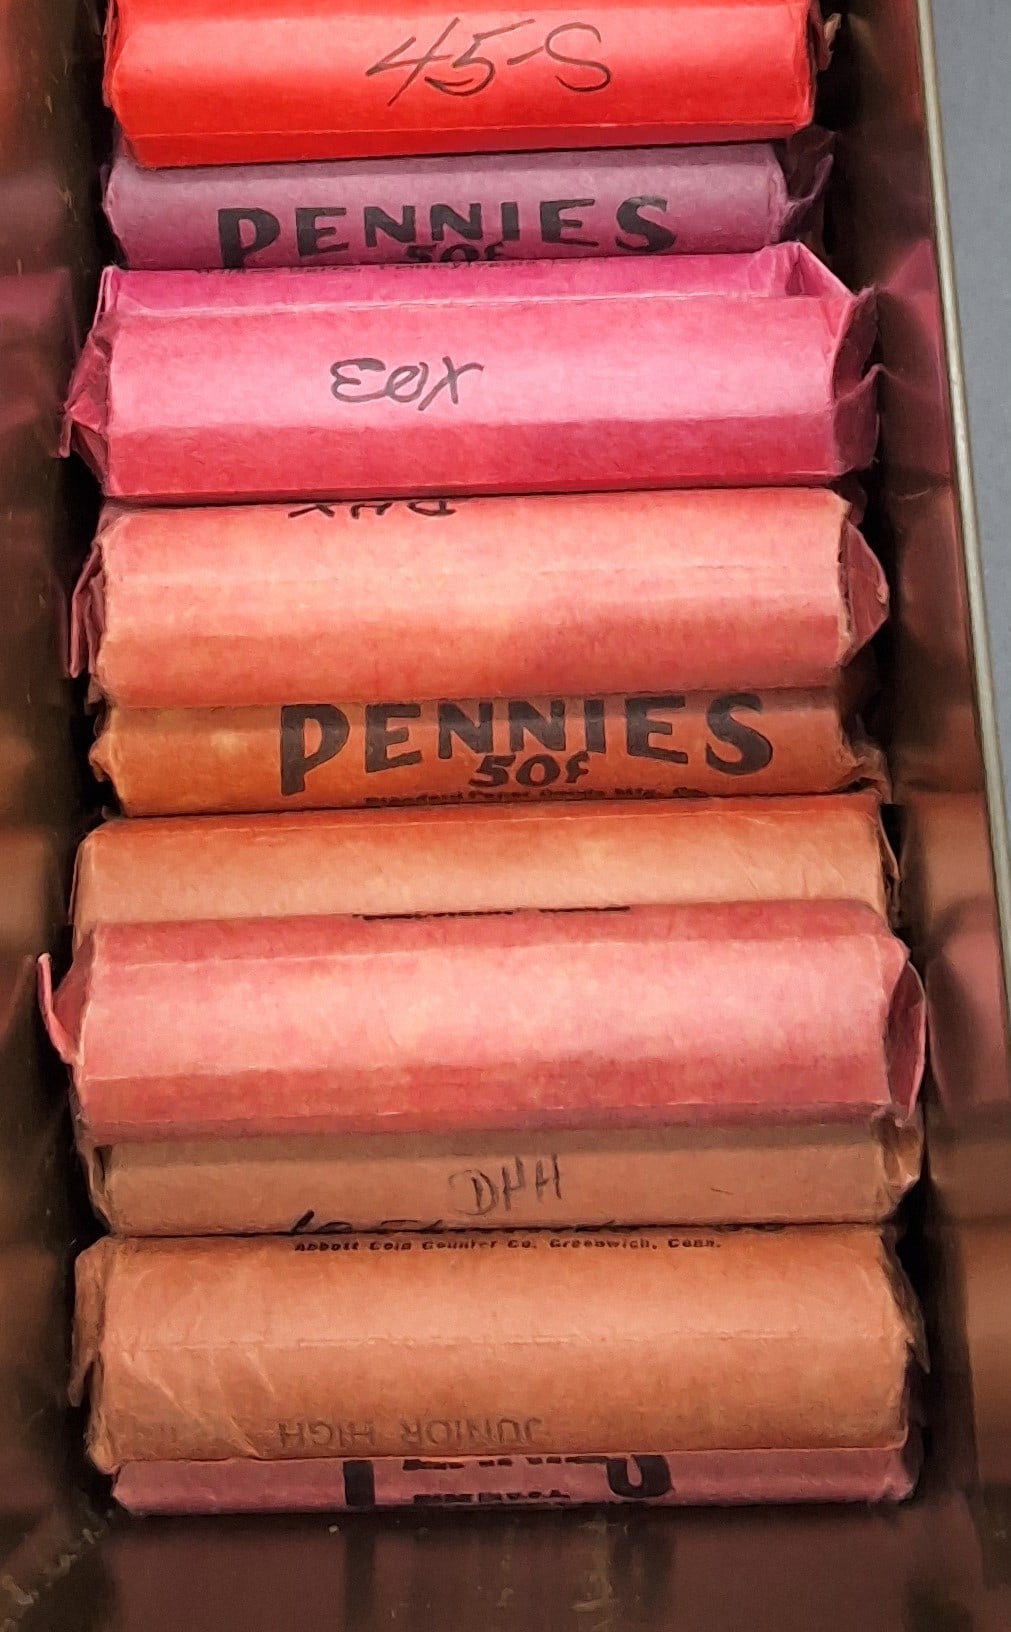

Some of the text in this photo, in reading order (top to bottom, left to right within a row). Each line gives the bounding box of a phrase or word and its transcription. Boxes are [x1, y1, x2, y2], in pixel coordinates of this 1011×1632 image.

[365, 17, 612, 107] 45-S
[217, 195, 677, 271] PENNIES
[280, 693, 774, 796] PENNIES
[277, 1416, 543, 1449] JUNIOR HIGH
